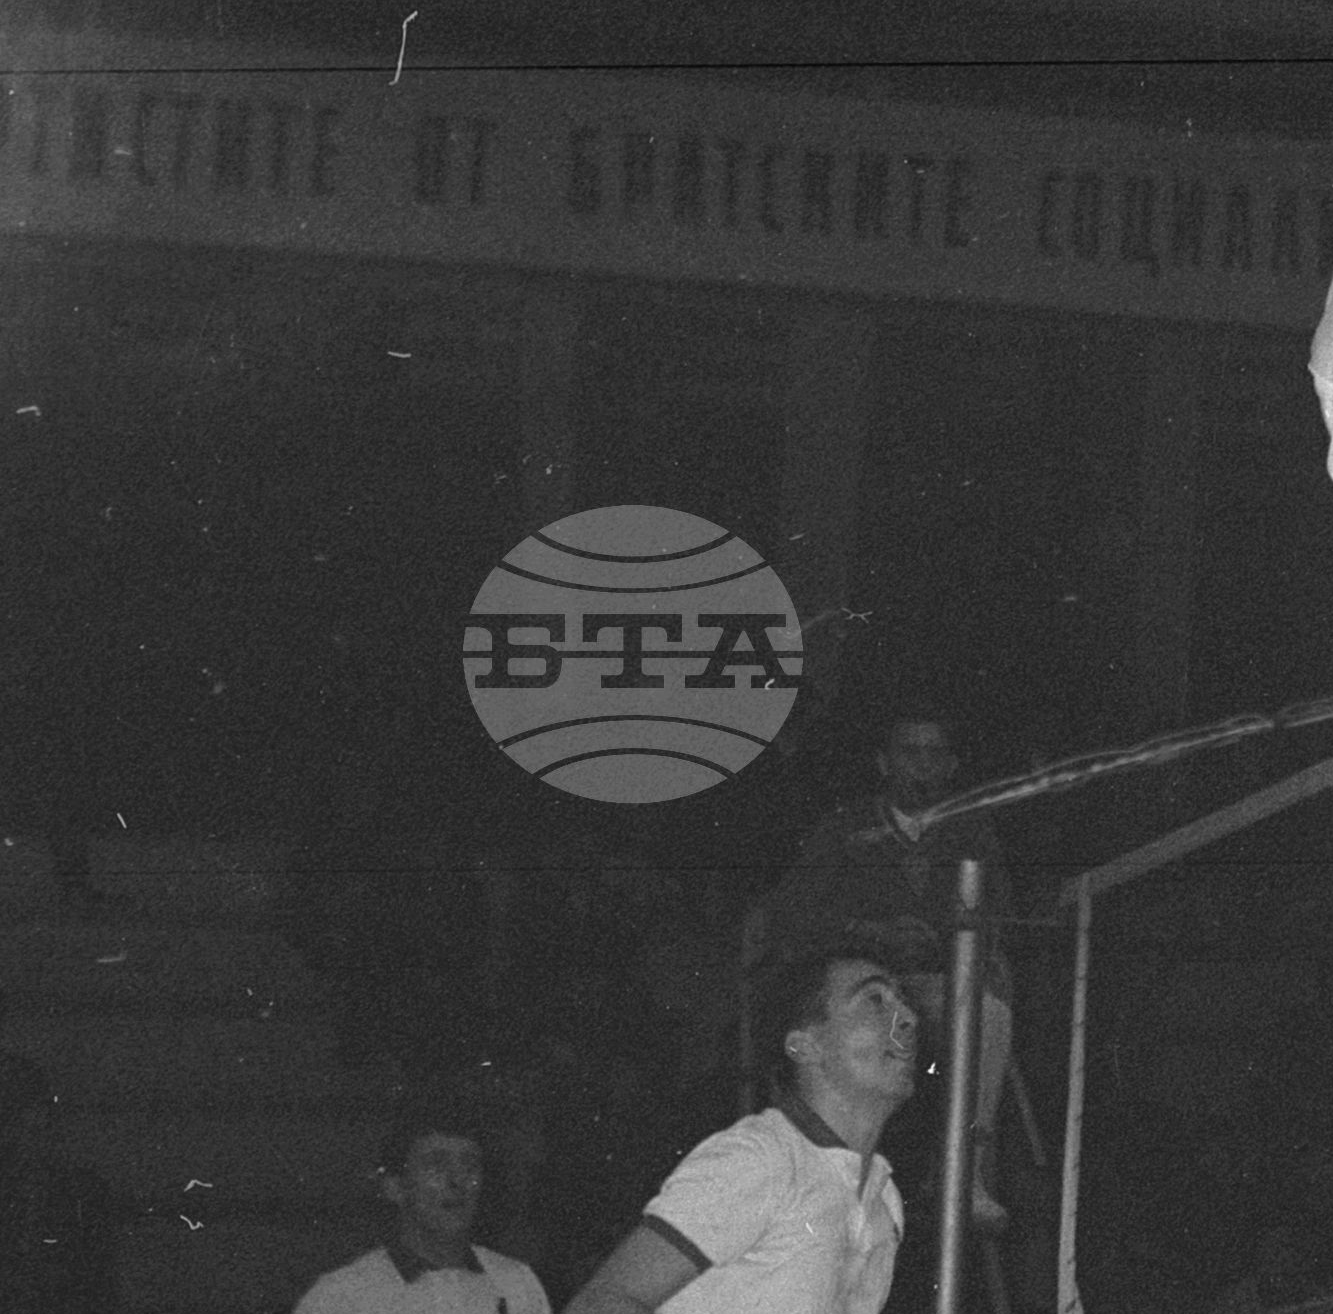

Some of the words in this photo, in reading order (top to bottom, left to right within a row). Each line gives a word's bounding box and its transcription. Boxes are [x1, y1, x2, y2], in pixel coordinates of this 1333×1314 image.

[0, 87, 338, 197] ТИСТИТЕ
[413, 115, 497, 207] ОТ
[566, 123, 972, 248] БРАТСКИТЕ
